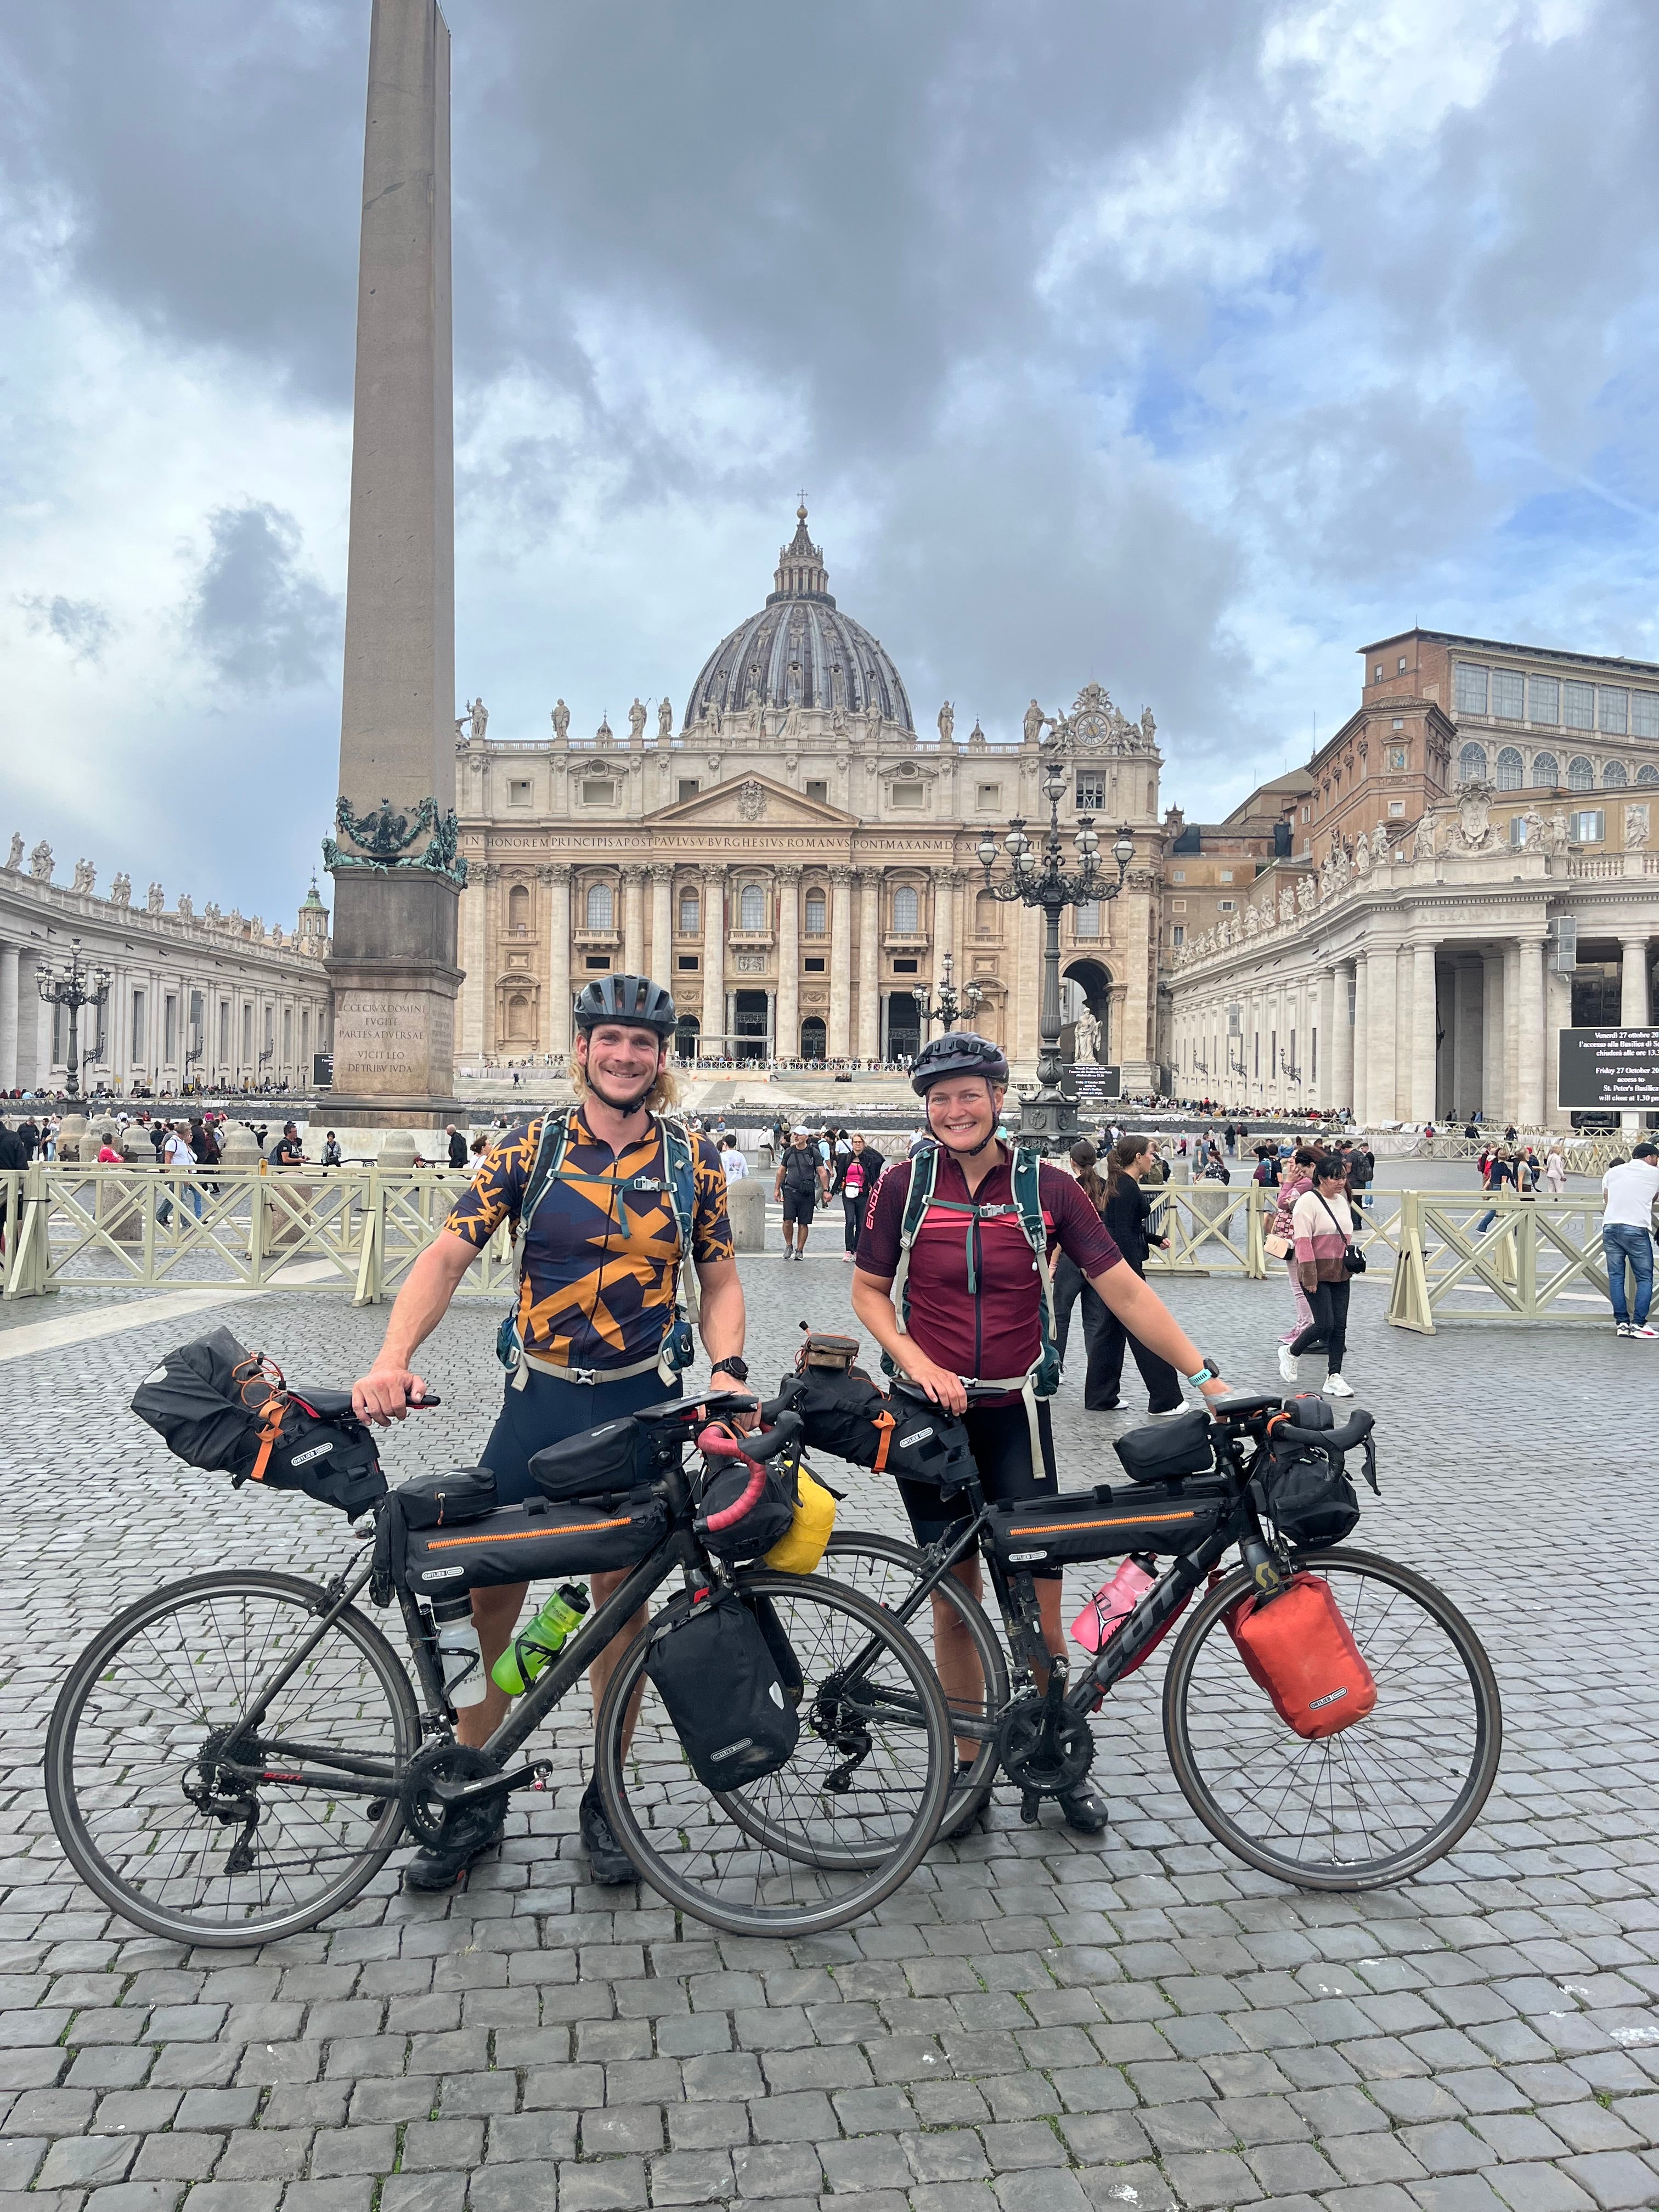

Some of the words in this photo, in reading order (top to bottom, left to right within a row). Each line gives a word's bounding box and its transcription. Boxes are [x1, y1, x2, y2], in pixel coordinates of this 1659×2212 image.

[465, 836, 479, 845] IN
[487, 838, 549, 848] HONOREM
[551, 837, 613, 847] PRINCIPIS
[616, 838, 653, 848] APOST
[654, 837, 696, 847] PAVLVS
[708, 837, 783, 848] BVRGHESIVS
[787, 838, 850, 848] ROMANVS
[853, 839, 885, 849] PONT
[885, 839, 913, 850] MAX
[362, 1004, 386, 1013] CRVX
[387, 1005, 426, 1013] DOMINI
[365, 1018, 399, 1026] FVGITE
[339, 1030, 372, 1038] PARTES
[375, 1031, 425, 1040] ADVERSAE
[358, 1051, 385, 1059] VICIT
[387, 1051, 404, 1059] LEO
[348, 1063, 360, 1072] DE
[361, 1064, 387, 1073] TRIBV
[390, 1065, 412, 1073] IVDA
[1595, 1067, 1615, 1075] Friday
[294, 1451, 315, 1464] ORTLIEB
[1311, 1696, 1331, 1708] ORTLIEB
[713, 1748, 734, 1759] ORTLIEB
[263, 1772, 303, 1781] SCOTT
